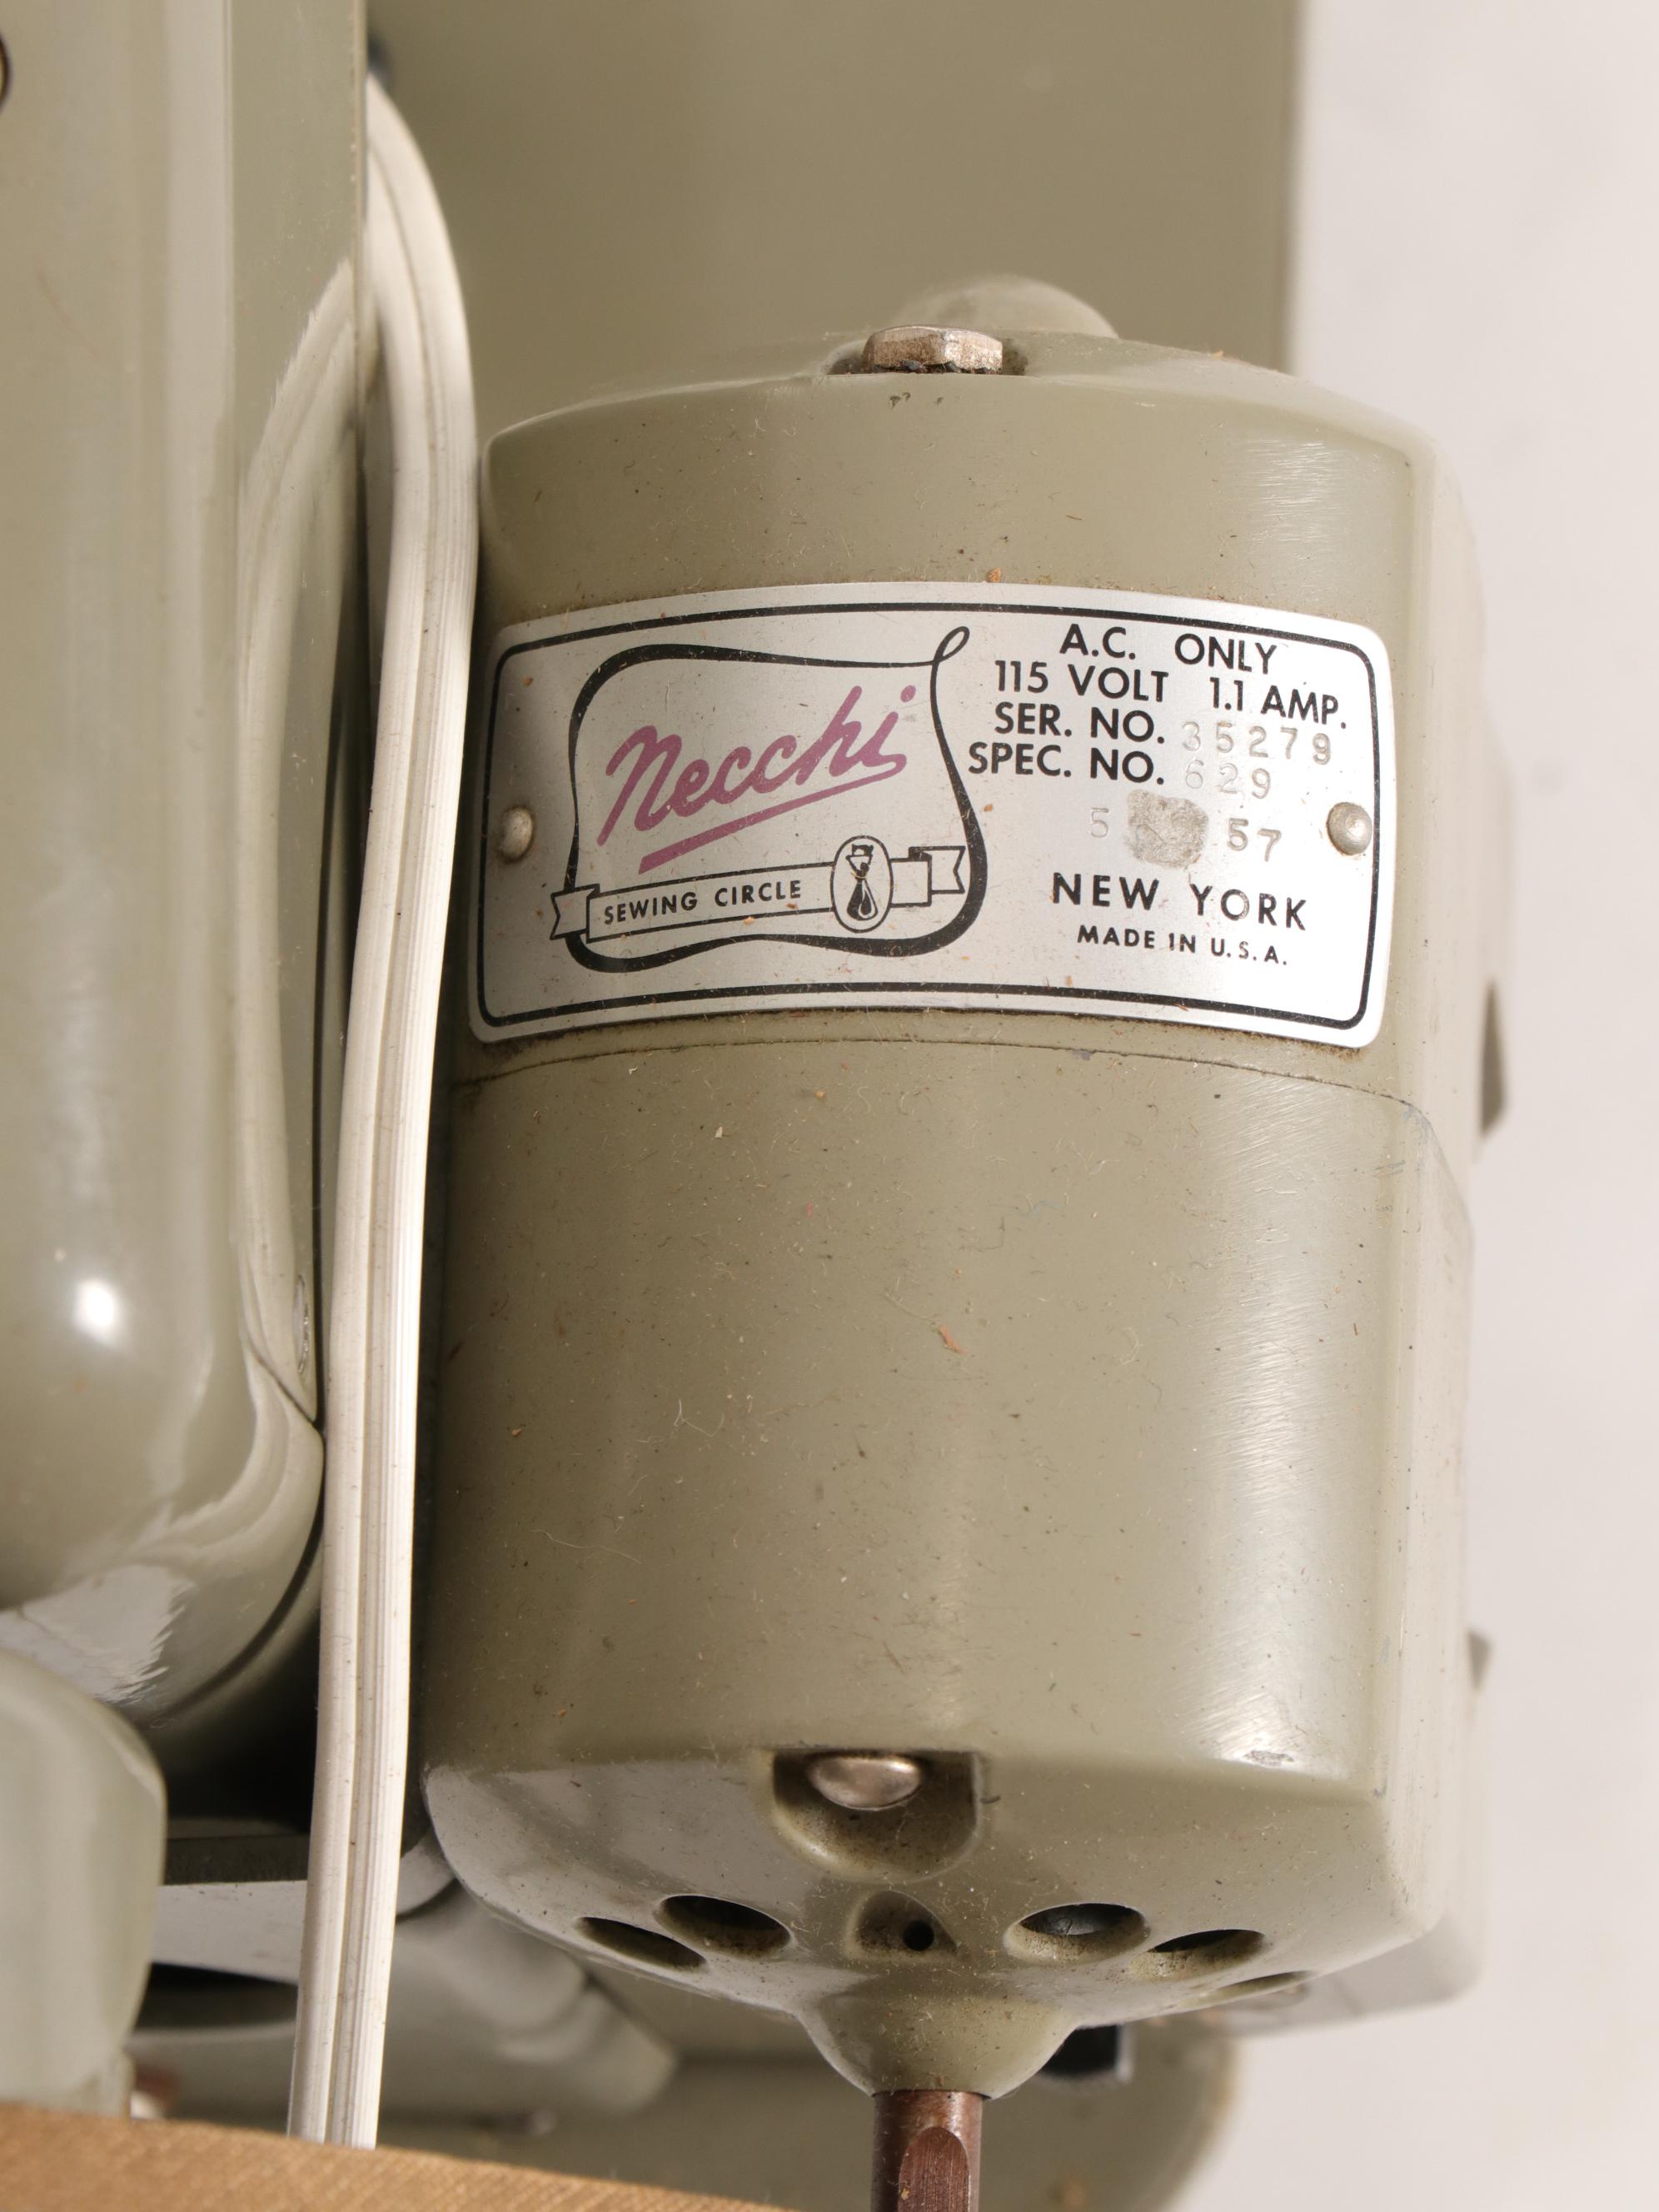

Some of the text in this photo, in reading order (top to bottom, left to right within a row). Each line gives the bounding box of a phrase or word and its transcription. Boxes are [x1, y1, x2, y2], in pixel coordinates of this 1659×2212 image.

[1059, 623, 1278, 675] A.C. ONLY
[994, 660, 1348, 730] 115 VOLT 1.1 AMP.
[994, 701, 1332, 765] SER. NO. 35279
[597, 685, 916, 848] Necchi
[968, 742, 1271, 800] SPEC. NO. 629
[1227, 817, 1282, 862] 57
[605, 879, 802, 925] SEWING CIRCLE
[1052, 873, 1308, 931] NEW YORK
[1078, 925, 1288, 965] MADE IN U.S.A.
